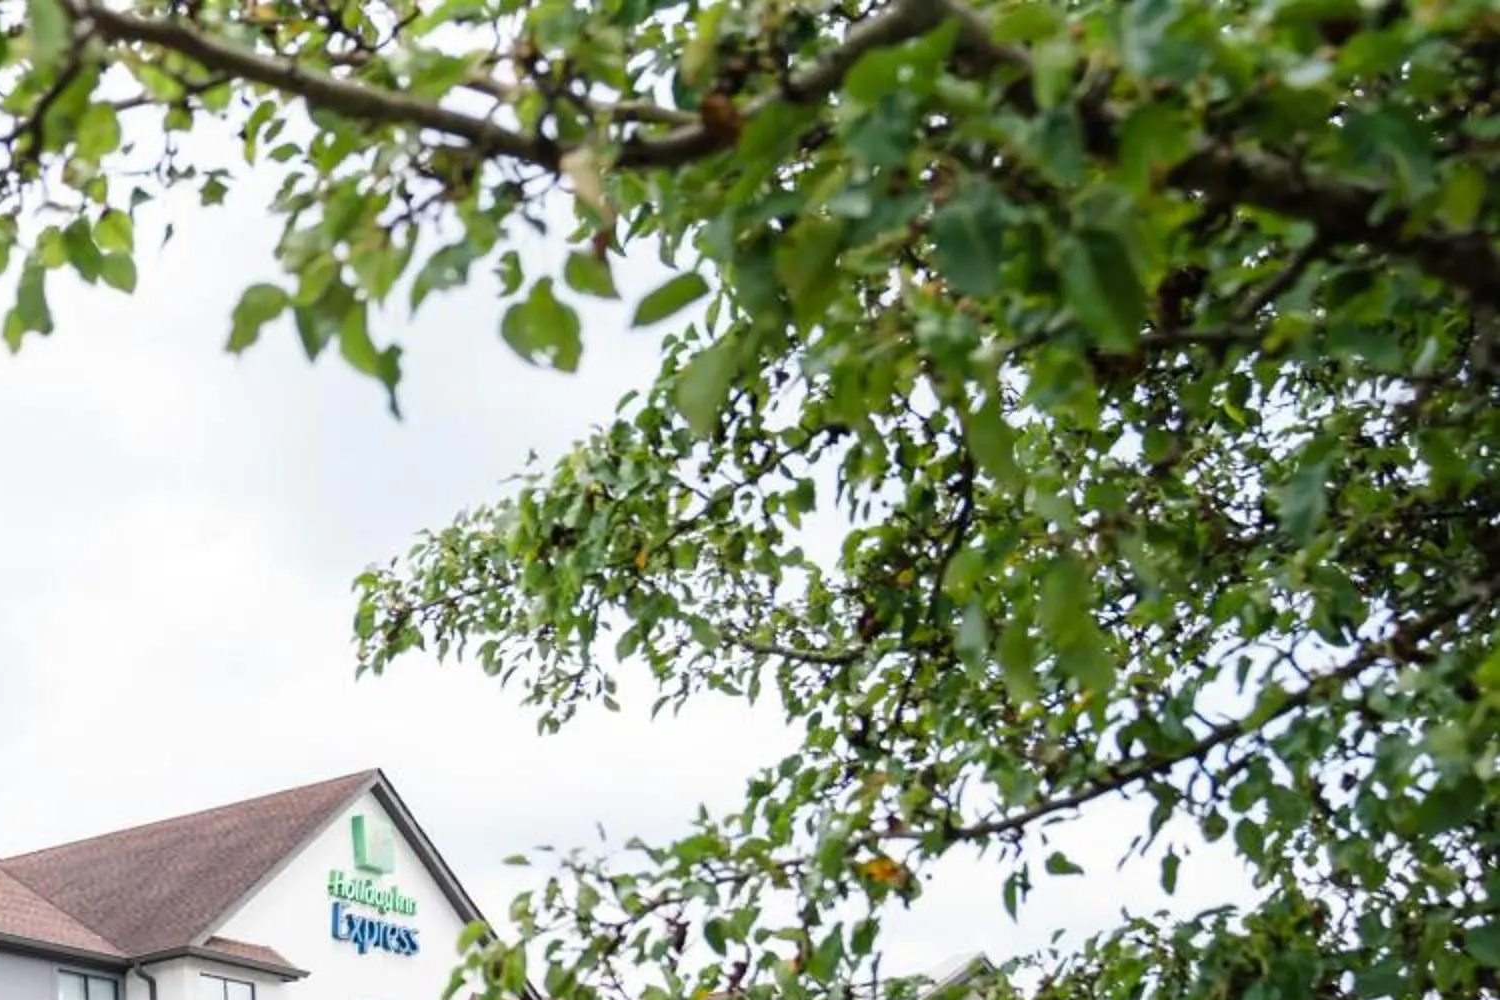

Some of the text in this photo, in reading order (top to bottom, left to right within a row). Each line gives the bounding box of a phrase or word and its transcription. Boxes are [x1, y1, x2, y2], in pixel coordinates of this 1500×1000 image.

[328, 870, 417, 916] Holiday Inn
[331, 901, 419, 955] Express
